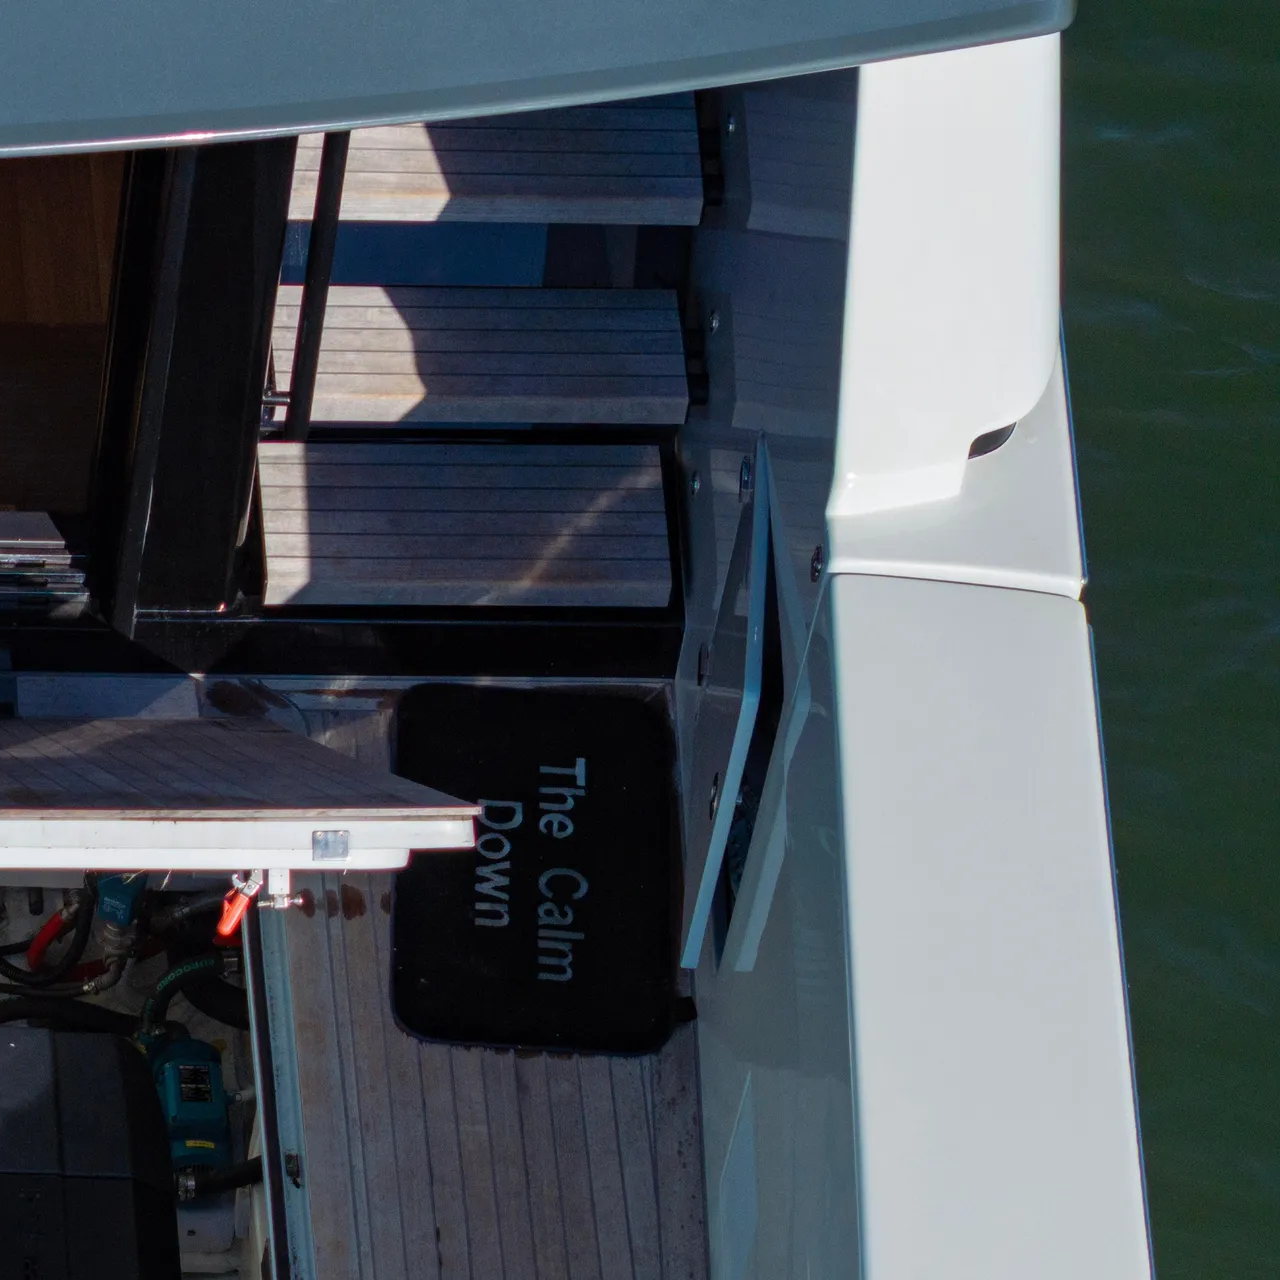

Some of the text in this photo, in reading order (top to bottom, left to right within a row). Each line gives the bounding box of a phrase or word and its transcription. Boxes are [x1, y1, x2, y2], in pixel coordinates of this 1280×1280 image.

[474, 798, 523, 928] Down
[536, 757, 589, 982] The Calm
